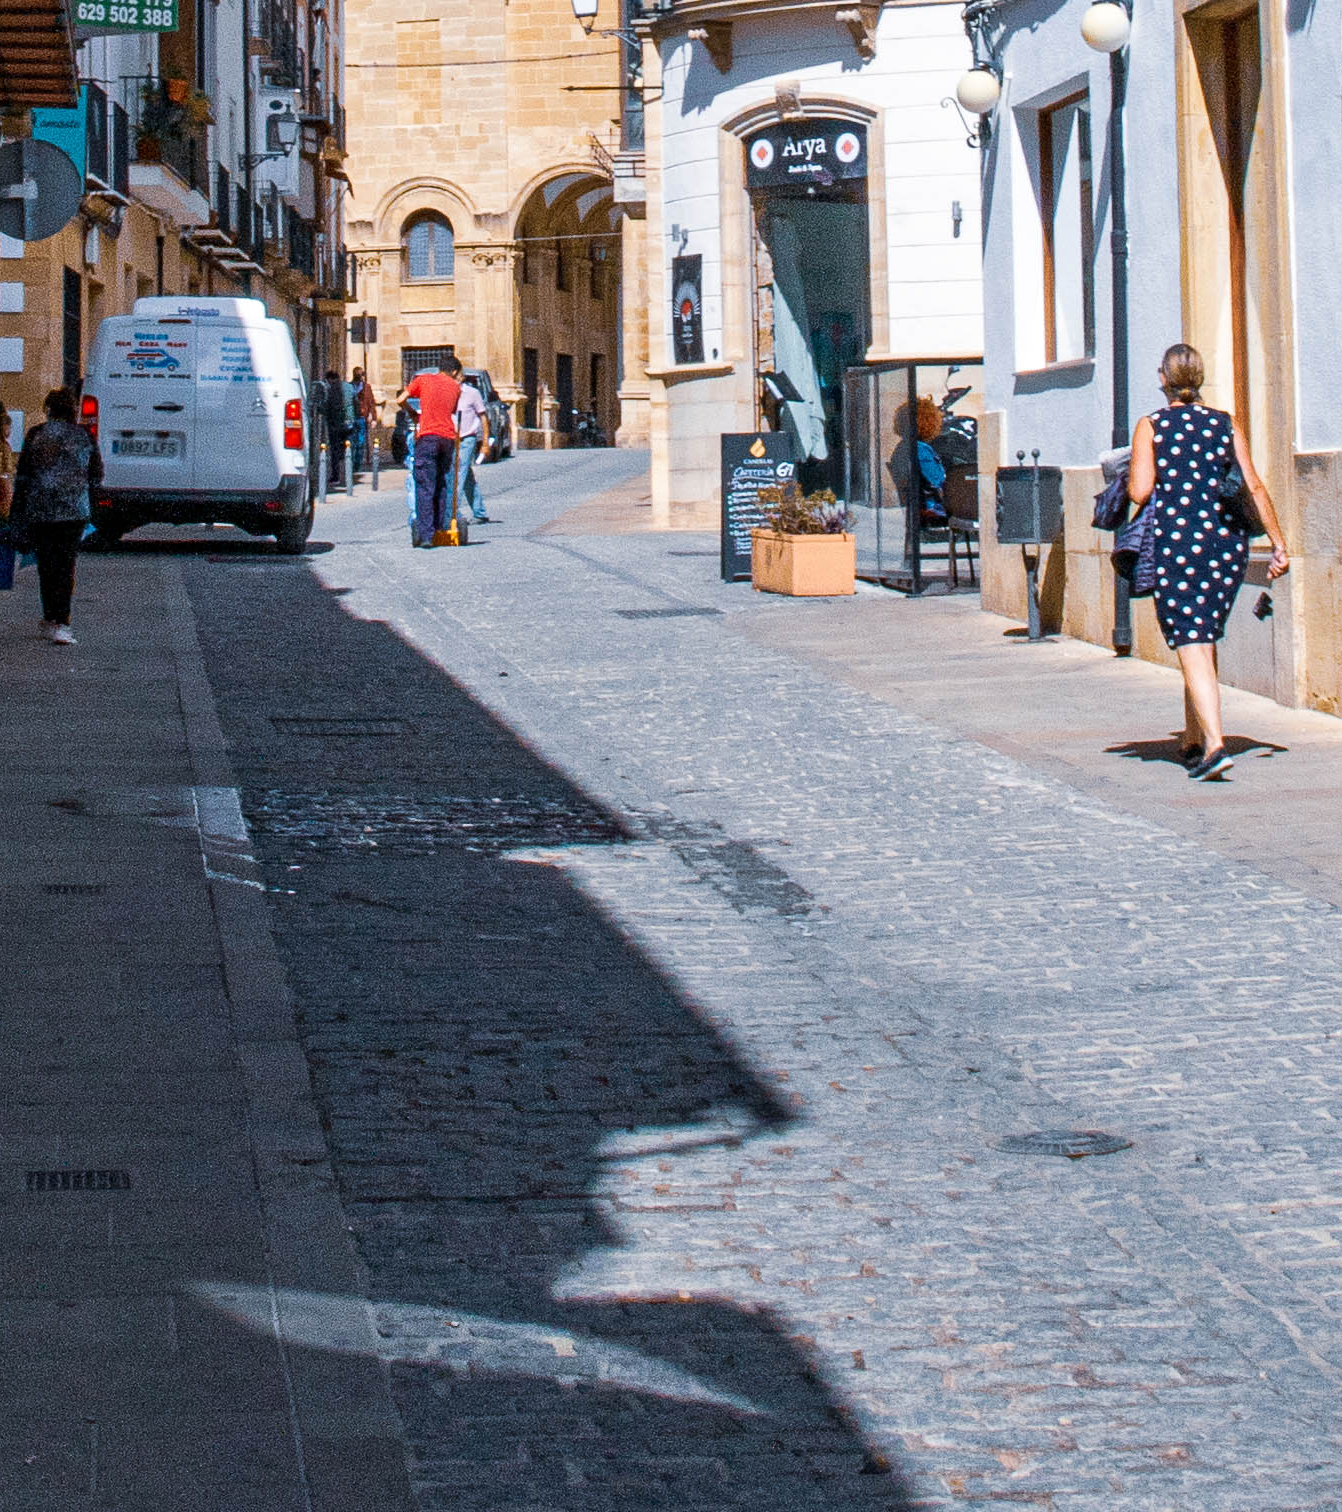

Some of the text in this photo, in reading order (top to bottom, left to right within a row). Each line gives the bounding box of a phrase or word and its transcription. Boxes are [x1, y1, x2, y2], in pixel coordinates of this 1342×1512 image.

[77, 2, 173, 27] 629 502 388
[781, 136, 827, 161] Arya
